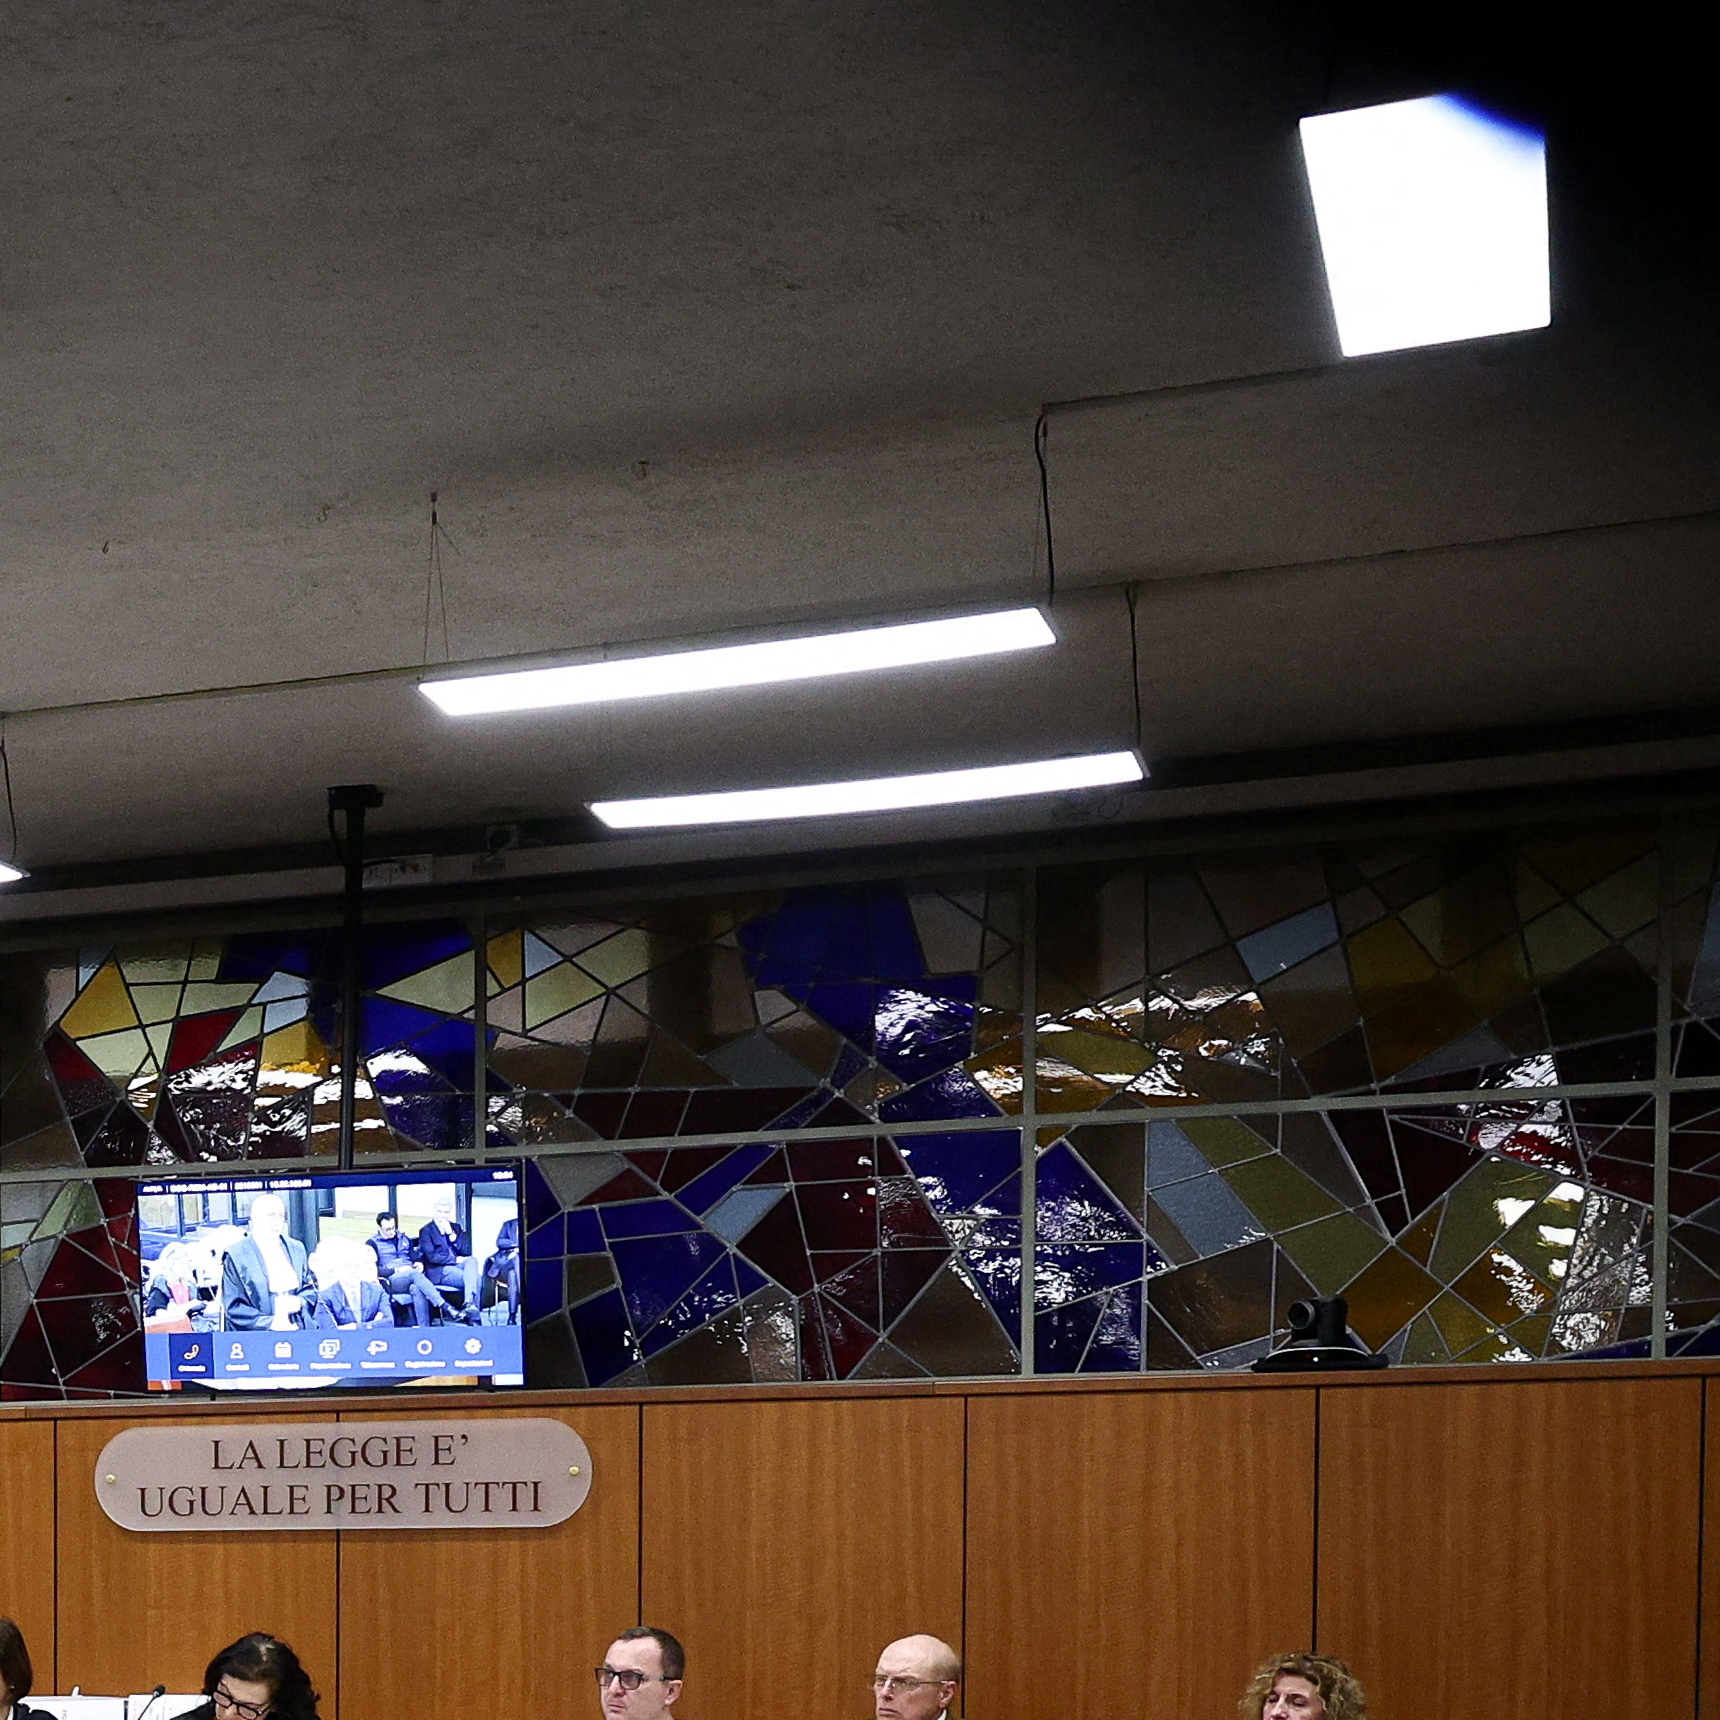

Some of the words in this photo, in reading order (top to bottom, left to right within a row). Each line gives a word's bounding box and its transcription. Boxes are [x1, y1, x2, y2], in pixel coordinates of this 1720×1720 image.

[210, 1438, 266, 1470] LA
[277, 1435, 418, 1469] LEGGE
[431, 1433, 470, 1466] E'
[137, 1484, 311, 1517] UGUALE
[323, 1482, 402, 1515] PER
[414, 1480, 543, 1513] TUTTI
